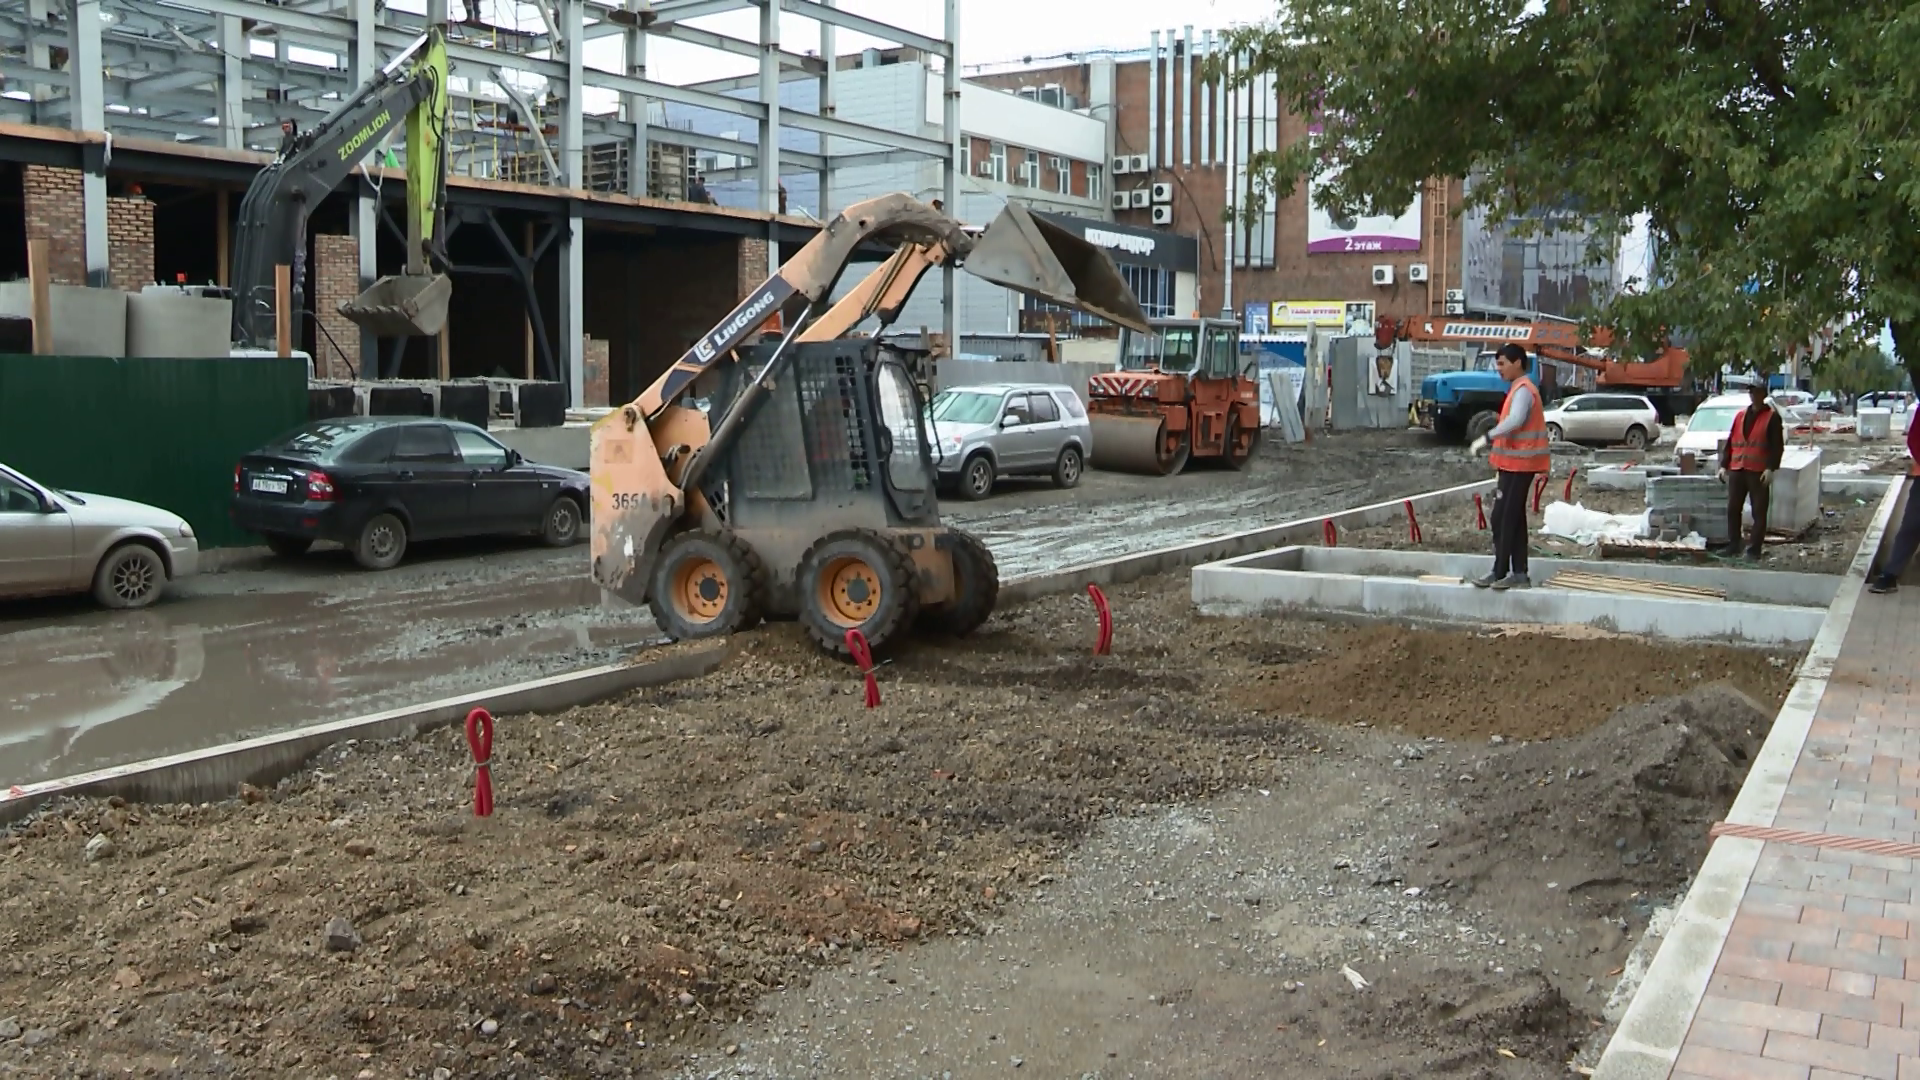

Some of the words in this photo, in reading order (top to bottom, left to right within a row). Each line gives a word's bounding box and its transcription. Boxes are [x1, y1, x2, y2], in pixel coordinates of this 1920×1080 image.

[338, 109, 391, 161] ZOOMLION
[1345, 238, 1353, 250] 2
[1354, 241, 1382, 250] этаж
